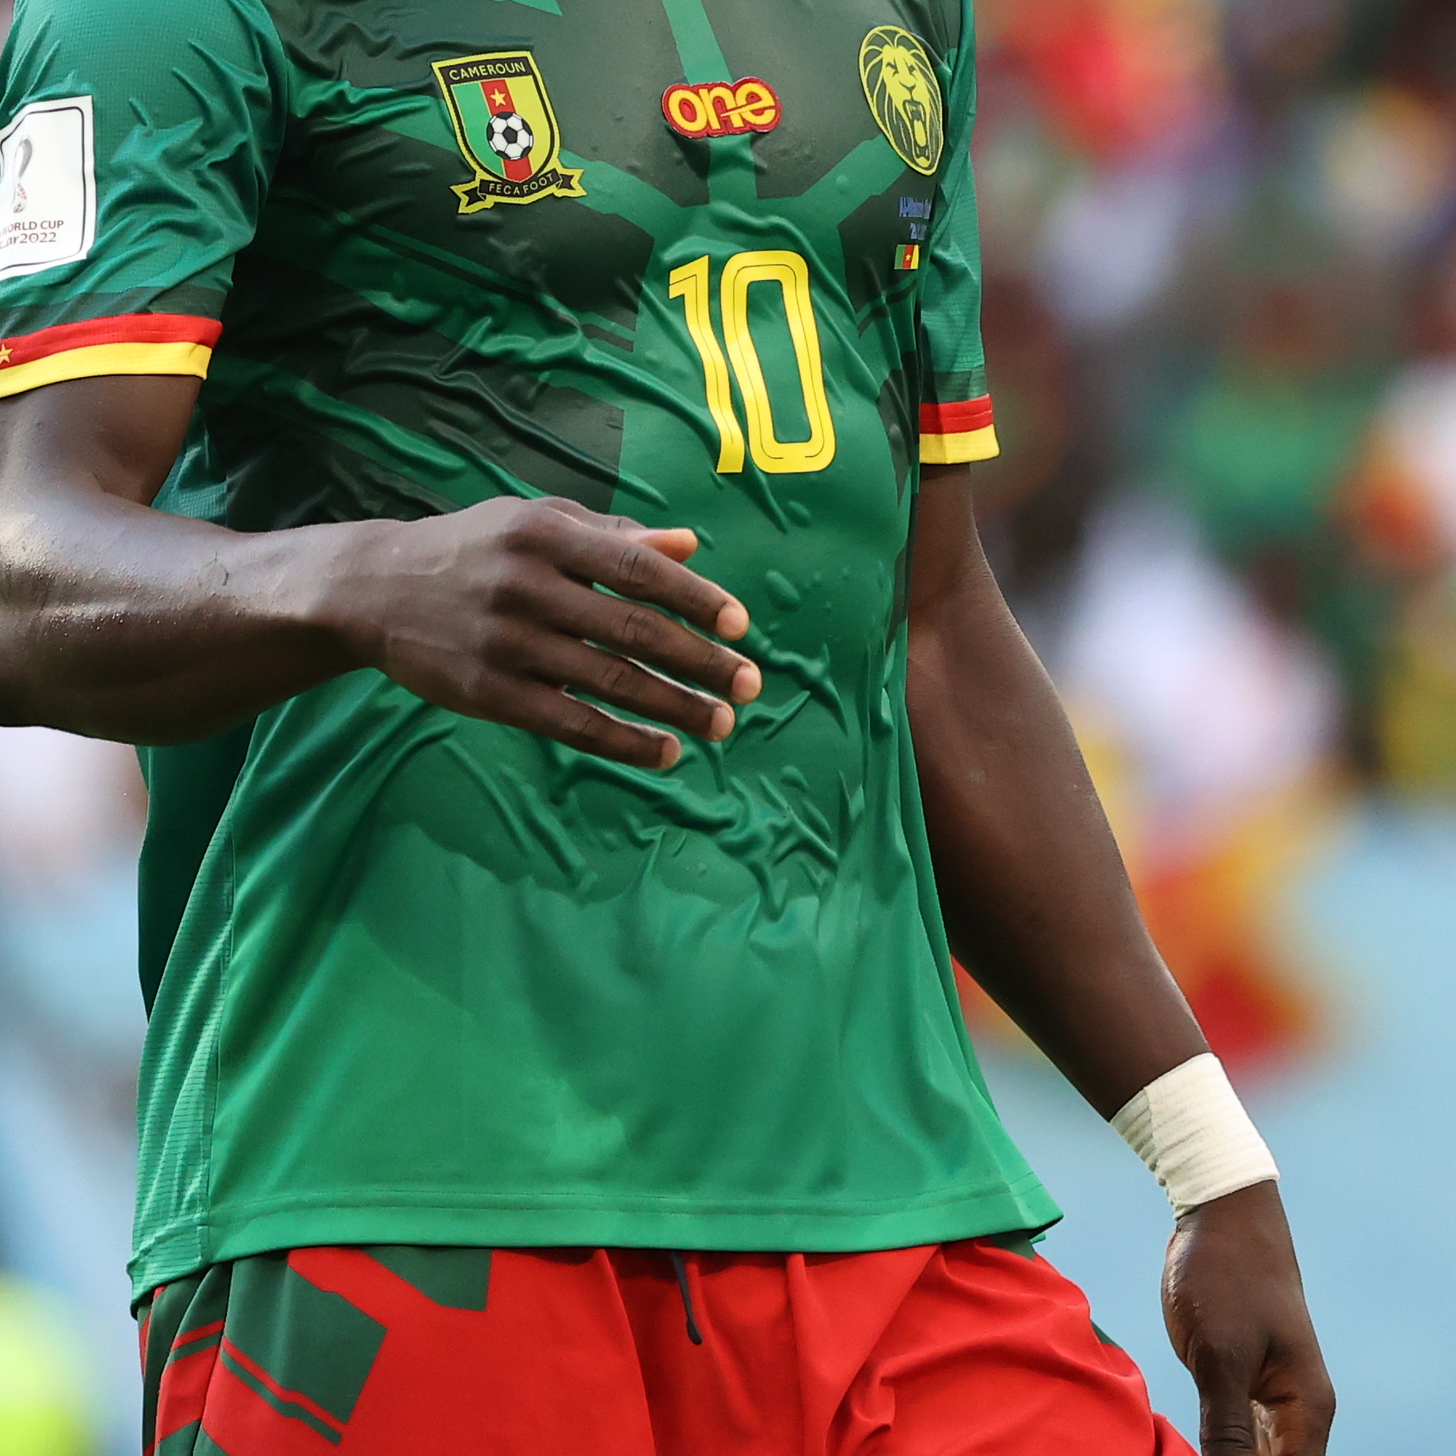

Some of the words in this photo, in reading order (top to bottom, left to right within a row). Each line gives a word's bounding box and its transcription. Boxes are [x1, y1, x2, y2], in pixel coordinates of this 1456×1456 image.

[449, 61, 526, 81] CAMEROUN
[668, 82, 776, 132] one
[488, 173, 555, 196] FECAFOOT
[40, 219, 64, 230] CUP
[668, 250, 836, 474] 10
